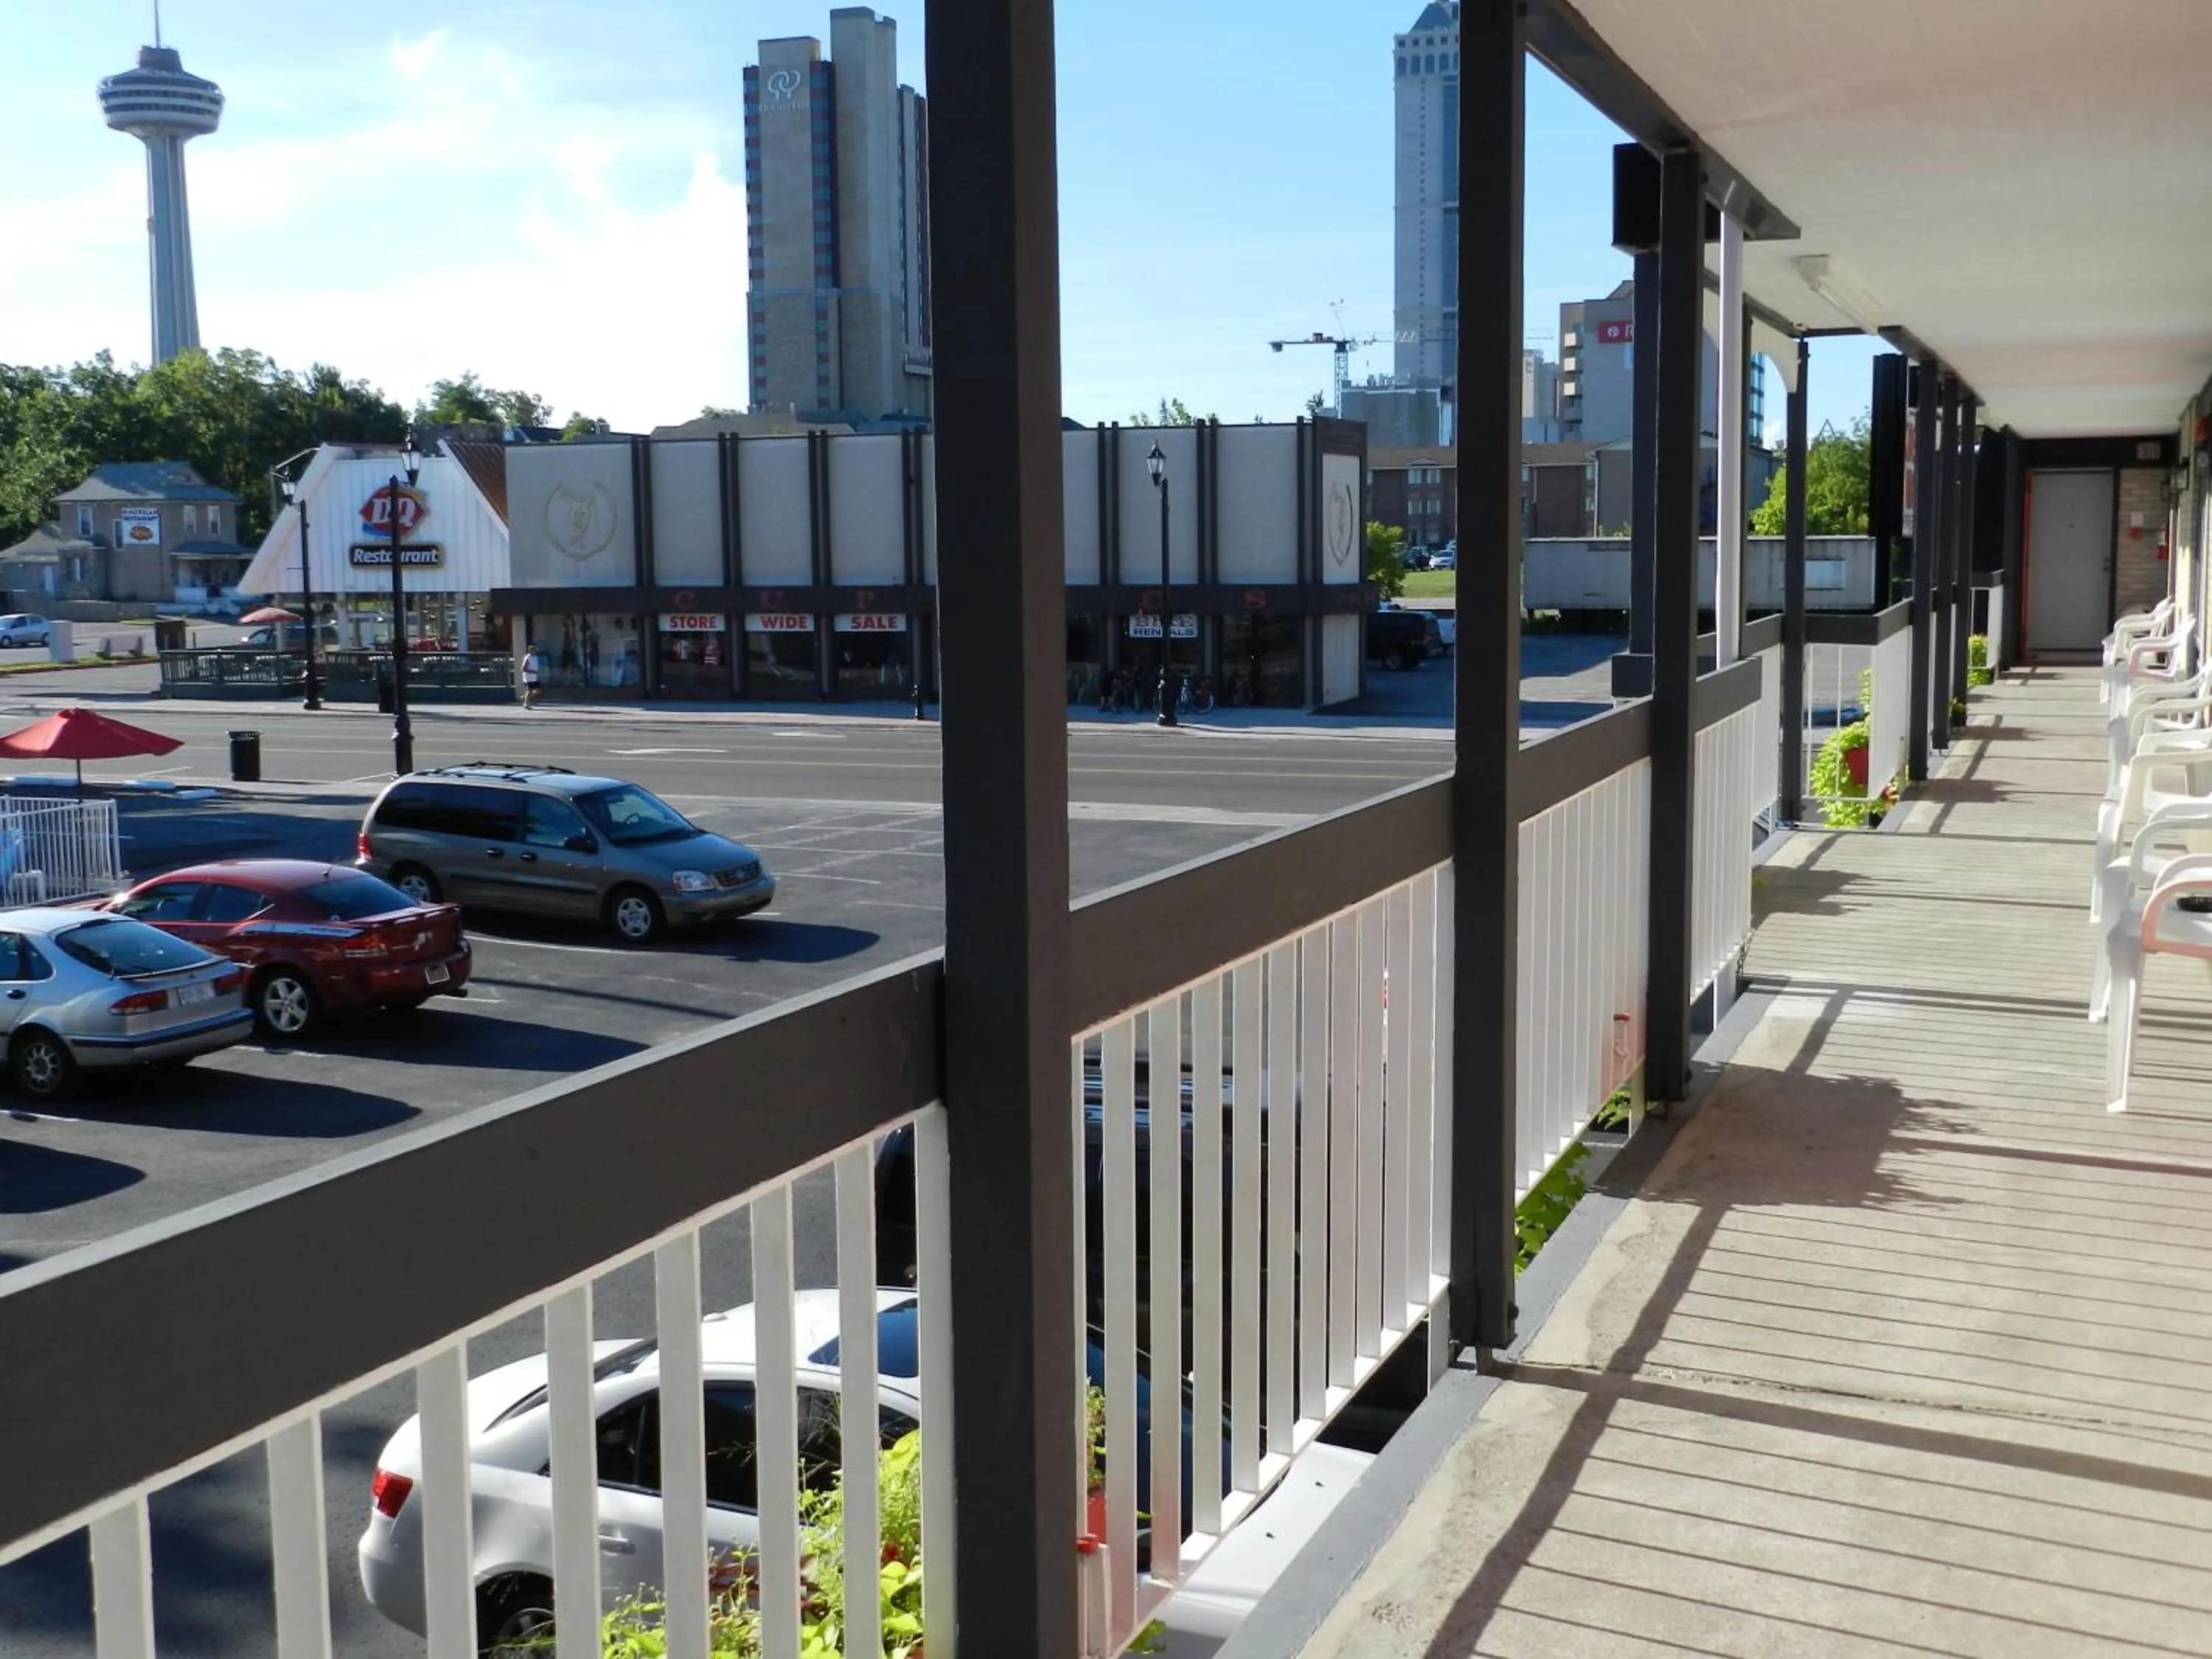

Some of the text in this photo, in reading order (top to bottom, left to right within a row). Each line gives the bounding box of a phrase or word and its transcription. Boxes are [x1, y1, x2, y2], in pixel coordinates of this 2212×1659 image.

[371, 496, 416, 528] DQ
[353, 548, 438, 563] Restarant
[669, 616, 898, 629] STORE WIDE SALE
[1133, 627, 1194, 636] RENALS
